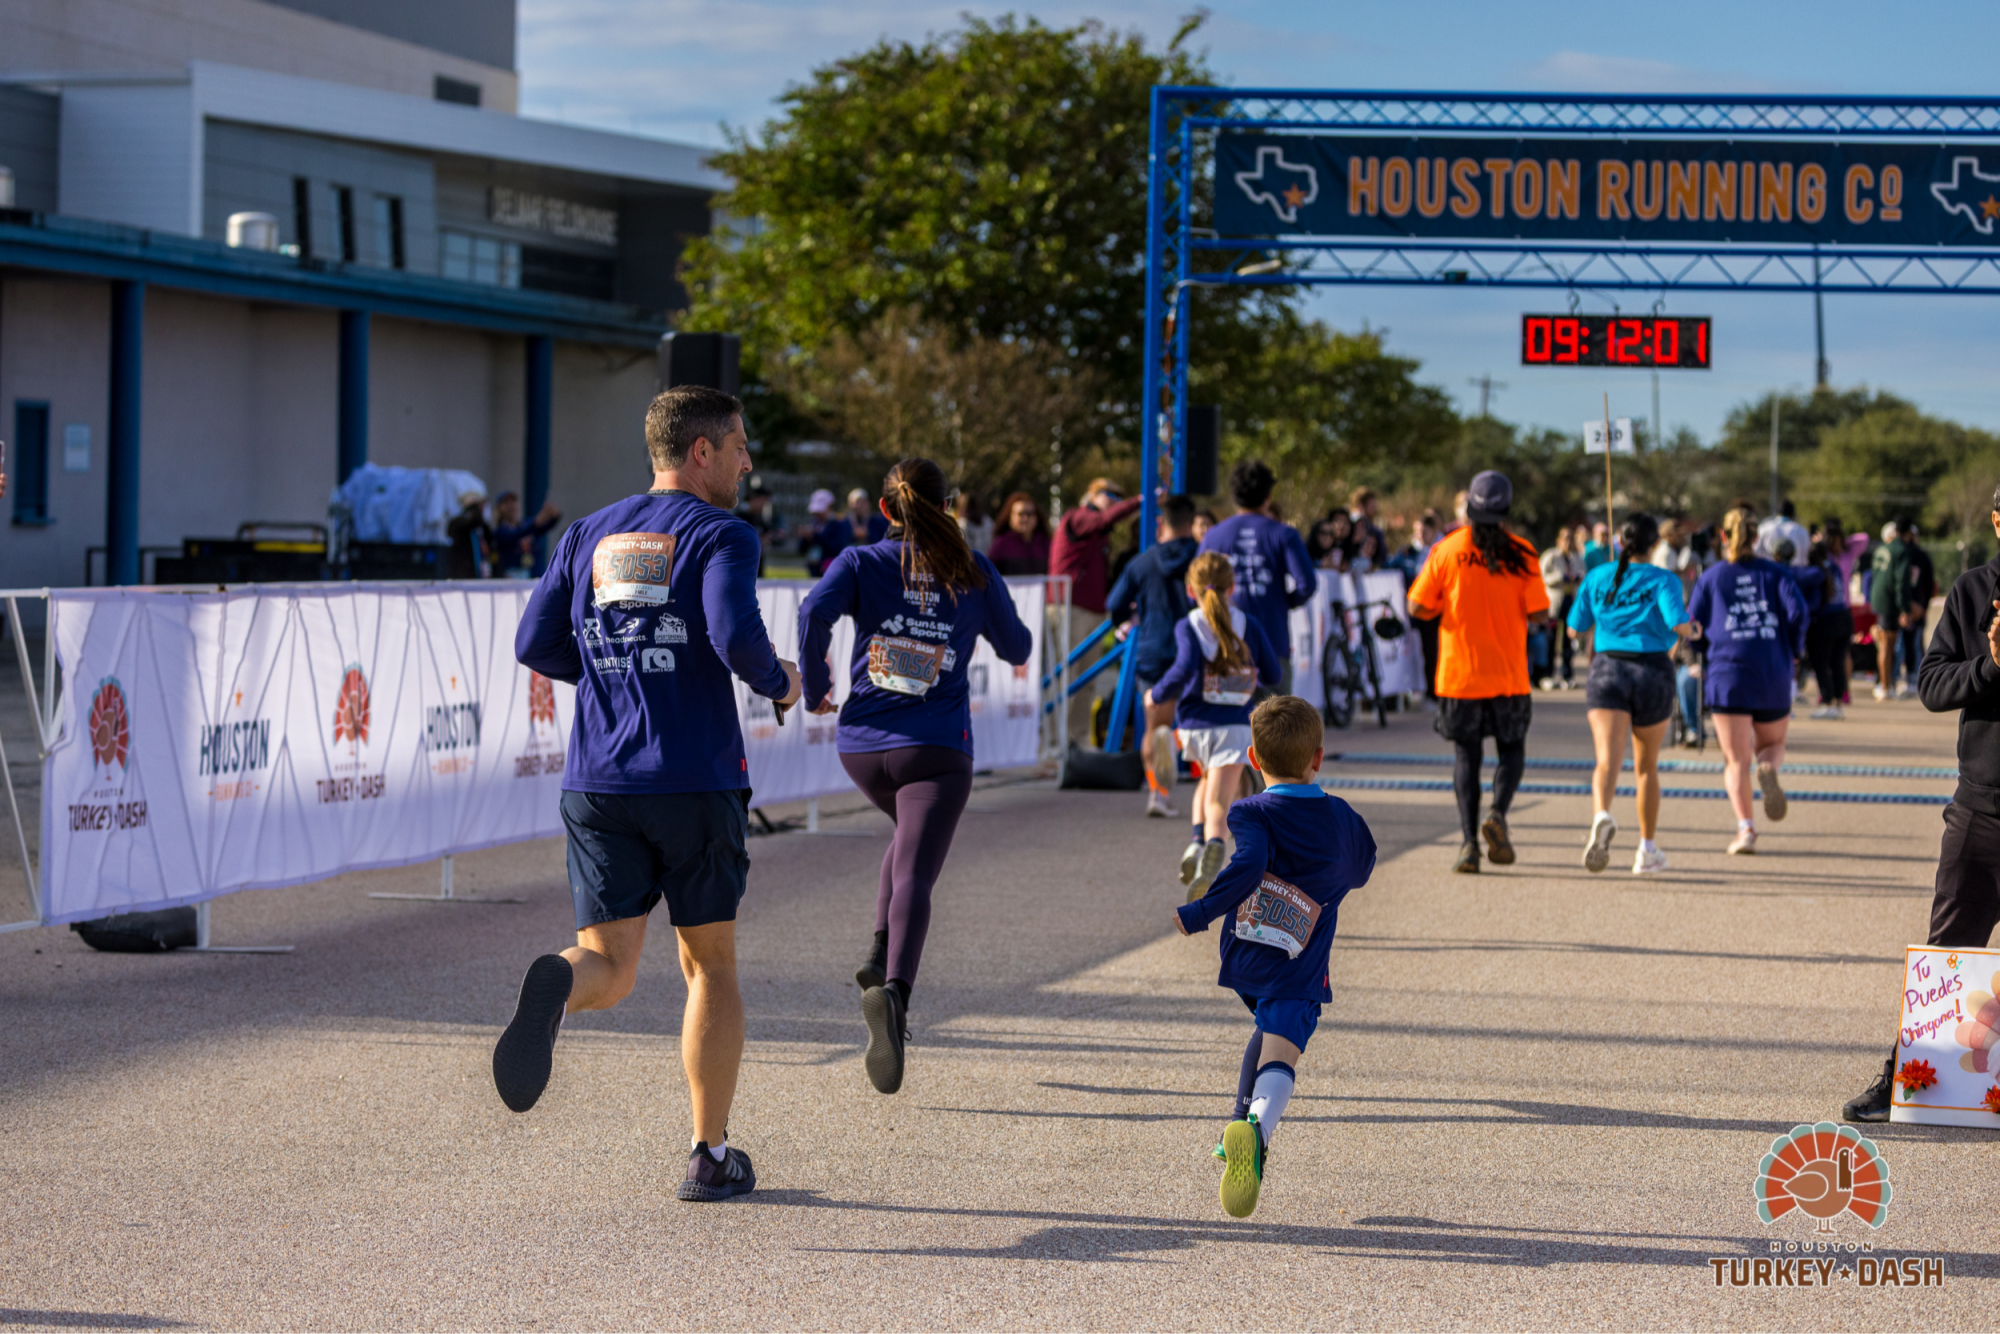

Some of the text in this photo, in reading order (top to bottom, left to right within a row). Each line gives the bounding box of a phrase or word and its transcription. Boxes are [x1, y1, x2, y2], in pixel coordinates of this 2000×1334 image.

[1348, 156, 1581, 220] HOUSTON
[1597, 159, 1827, 224] RUNNING
[1525, 317, 1707, 365] 09:12:01
[608, 541, 664, 550] TURKEY DASH
[607, 552, 668, 582] 5053
[1595, 589, 1654, 608] PCER
[885, 637, 913, 649] TURKEY
[915, 642, 936, 655] DASH
[910, 626, 948, 640] Sports
[885, 648, 936, 682] 5056
[199, 718, 270, 777] HOUSTON
[118, 800, 148, 830] DASH
[1261, 879, 1312, 914] URKEY DASH
[1253, 892, 1312, 943] 5055
[1912, 955, 1931, 982] Tu
[1905, 974, 1963, 1014] Puedes
[1900, 998, 1965, 1048] Chingona!
